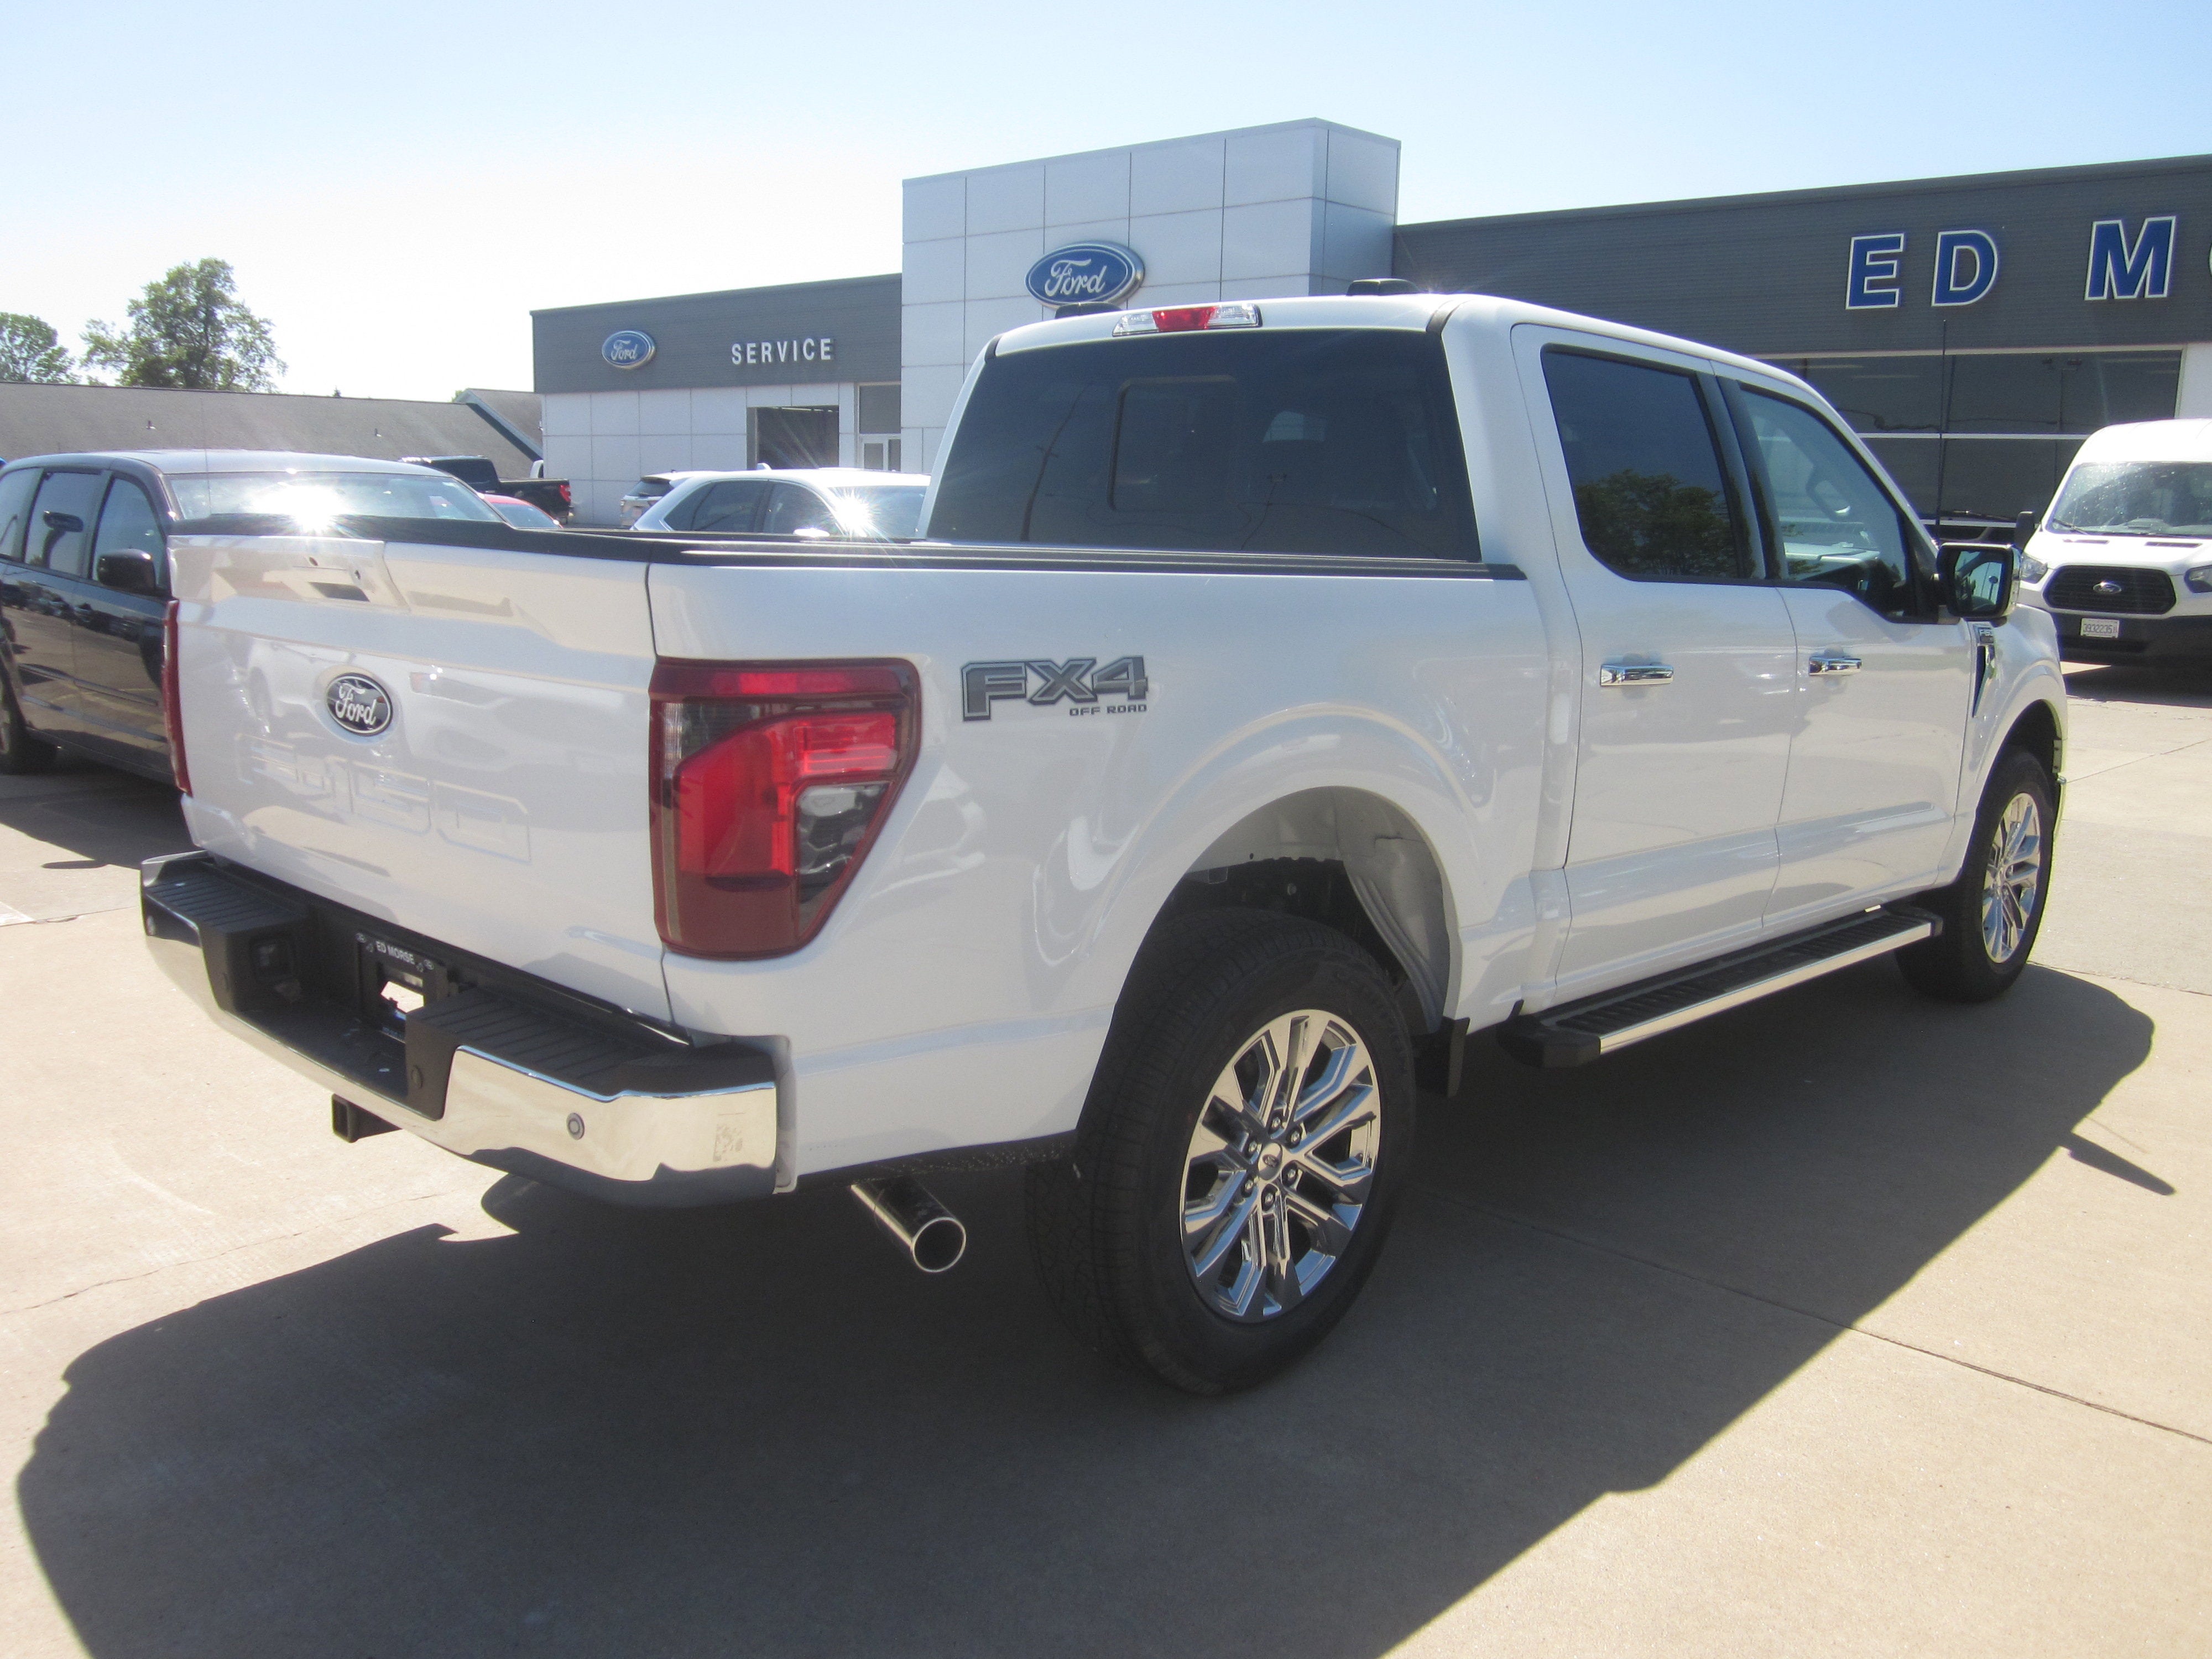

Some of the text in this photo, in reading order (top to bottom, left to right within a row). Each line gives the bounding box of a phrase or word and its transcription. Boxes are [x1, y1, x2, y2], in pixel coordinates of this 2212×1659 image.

[1044, 258, 1107, 297] Ford
[1845, 216, 2212, 310] ED M
[611, 340, 638, 361] Ford
[731, 338, 832, 365] SERVICE
[335, 682, 377, 726] Ford
[961, 655, 1149, 722] FX4
[1070, 703, 1147, 716] OFF ROAD
[375, 941, 387, 953] ED
[387, 946, 415, 965] MORSE
